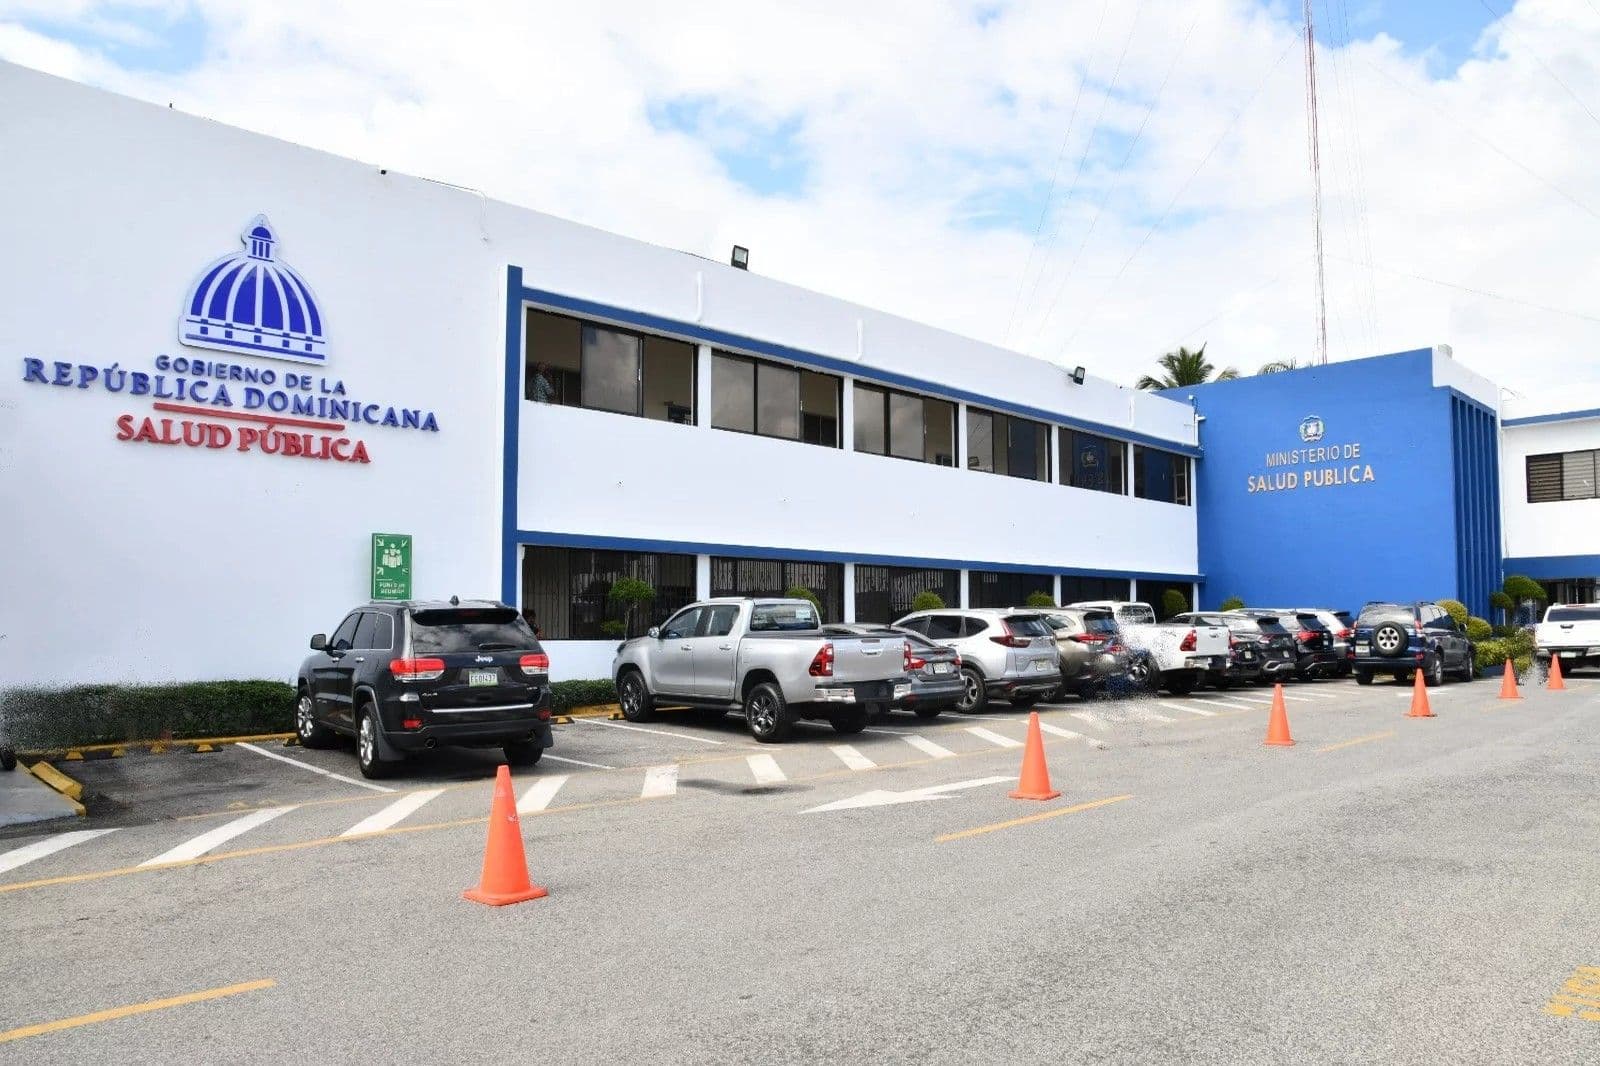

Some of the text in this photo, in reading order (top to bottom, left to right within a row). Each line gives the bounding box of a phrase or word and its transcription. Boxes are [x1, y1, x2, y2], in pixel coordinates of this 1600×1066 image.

[156, 355, 347, 396] GOBIERNO DE LA
[23, 357, 440, 432] REPÚBLICA DOMINICANA
[116, 414, 371, 464] SALUD PÚBLICA
[1266, 443, 1361, 467] MINISTERIO DE
[1247, 464, 1375, 493] SALUD PUBLICA
[475, 655, 494, 663] Jeep
